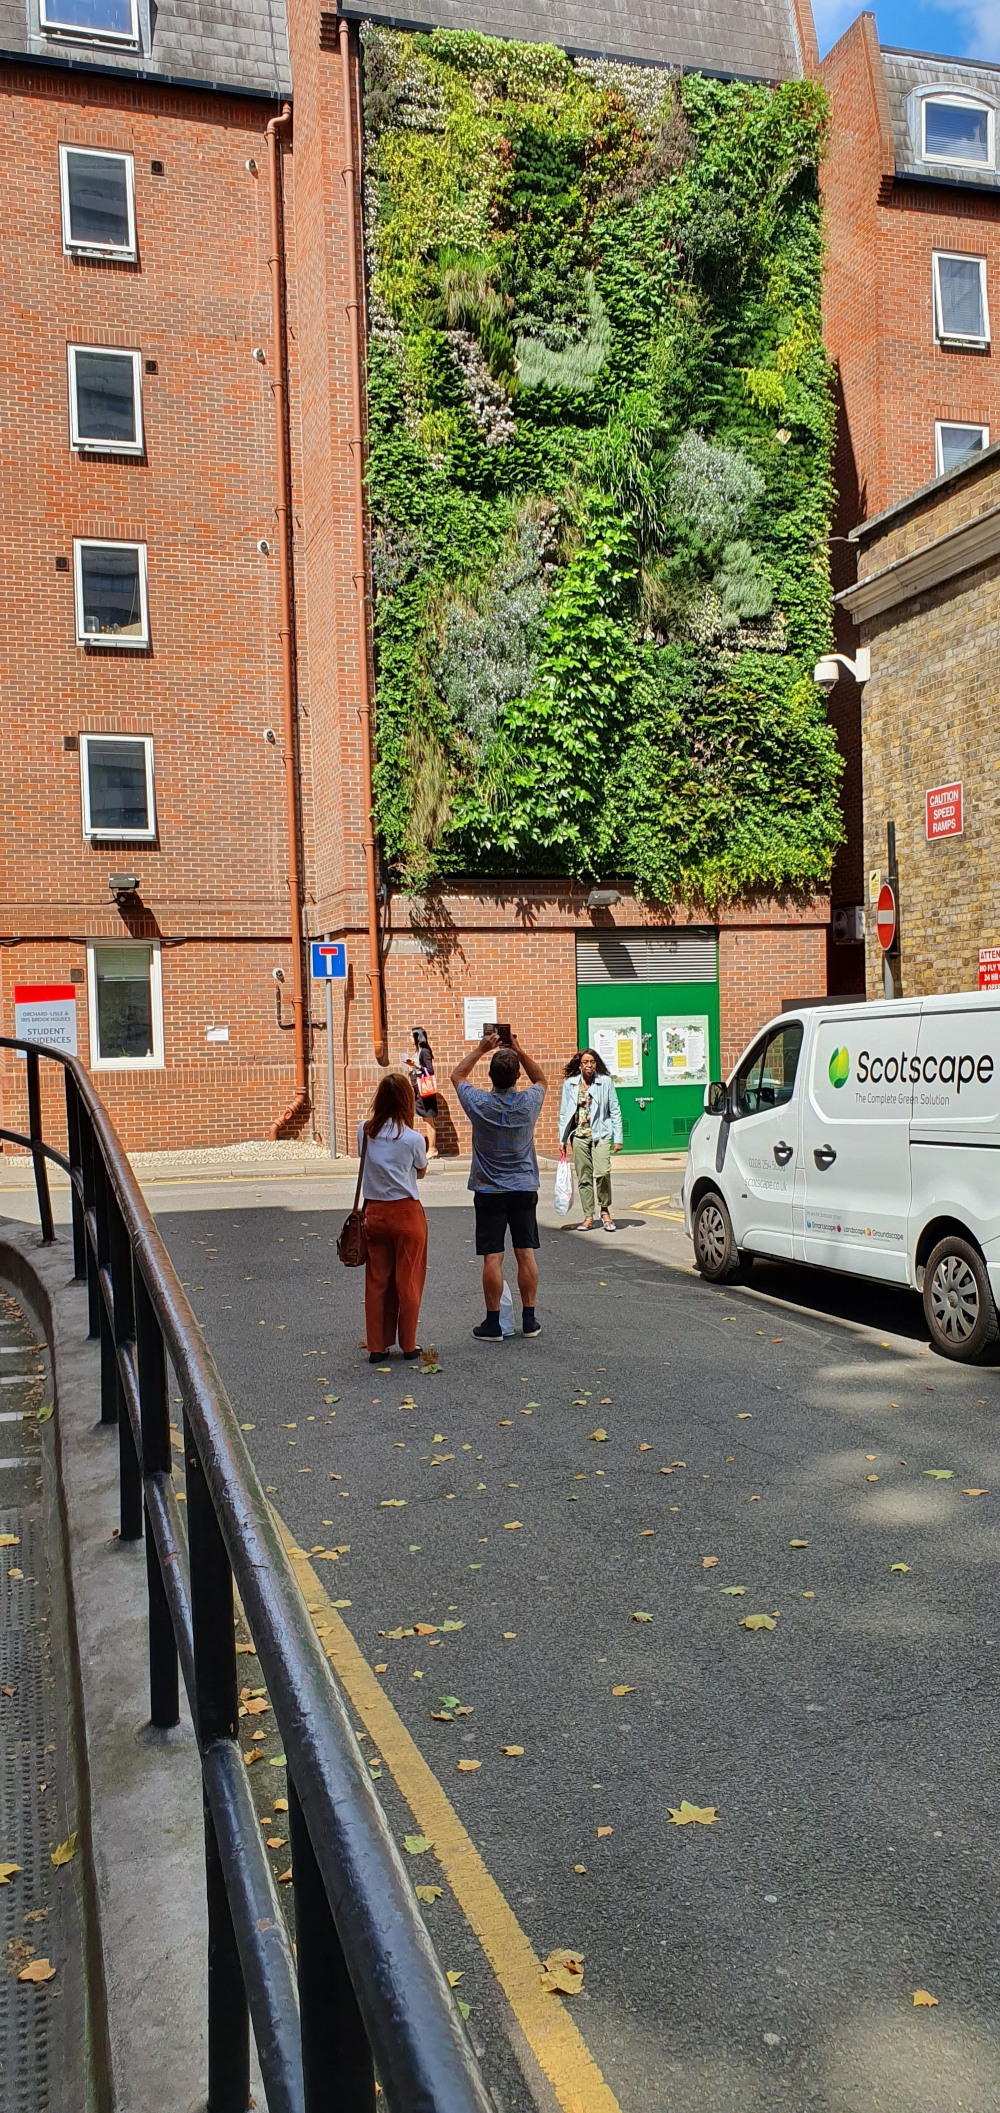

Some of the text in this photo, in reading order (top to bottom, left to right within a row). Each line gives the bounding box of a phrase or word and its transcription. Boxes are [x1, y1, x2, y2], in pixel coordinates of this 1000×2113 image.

[930, 789, 959, 806] CAUTION
[933, 805, 955, 820] SPEED
[933, 818, 956, 834] RAMPS
[856, 1050, 994, 1094] Scotscape
[855, 1092, 950, 1106] The Complete Green Solution
[843, 1226, 866, 1235] Landscape
[872, 1229, 904, 1240] Groundscape
